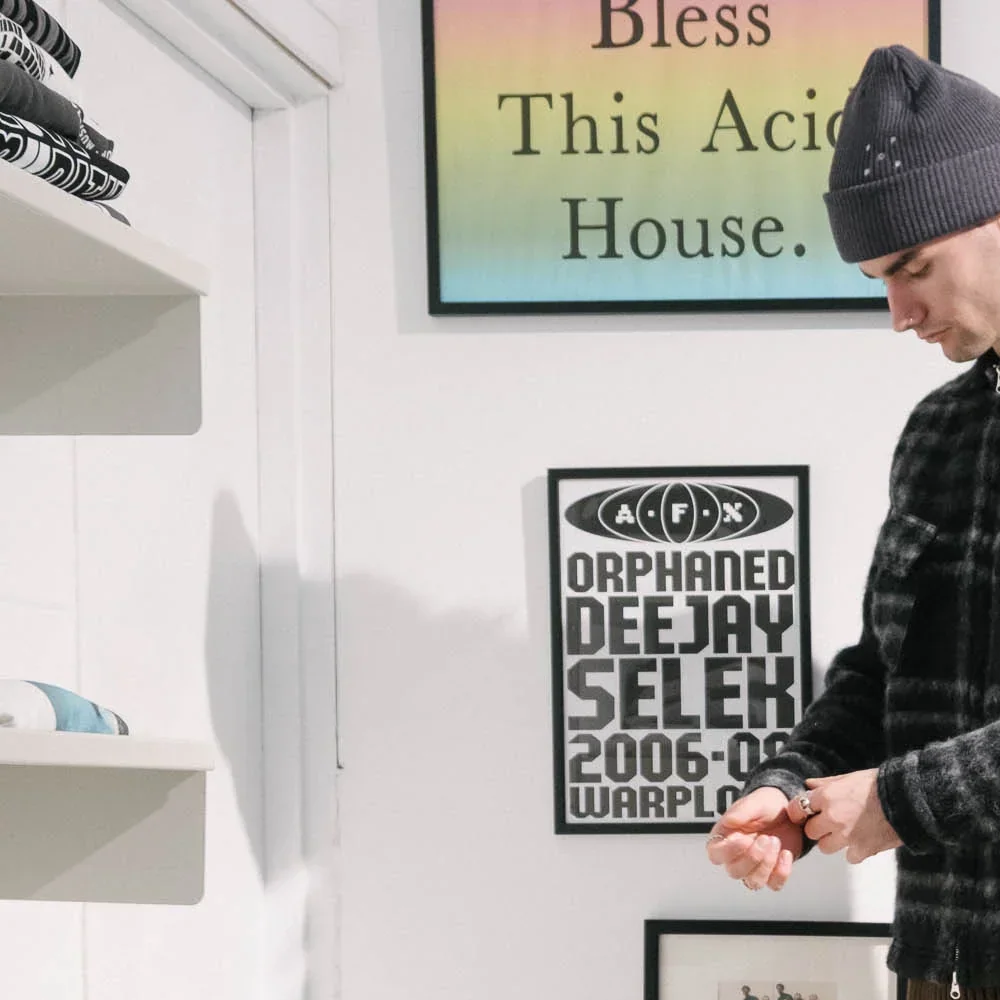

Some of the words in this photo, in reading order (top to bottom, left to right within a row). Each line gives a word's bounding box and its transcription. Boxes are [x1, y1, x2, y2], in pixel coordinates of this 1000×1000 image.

[591, 0, 771, 48] Bless
[497, 92, 660, 155] This
[561, 197, 806, 259] House.
[566, 549, 796, 593] ORPHANED
[566, 594, 794, 656] DEEJAY
[566, 656, 795, 731] SELEK
